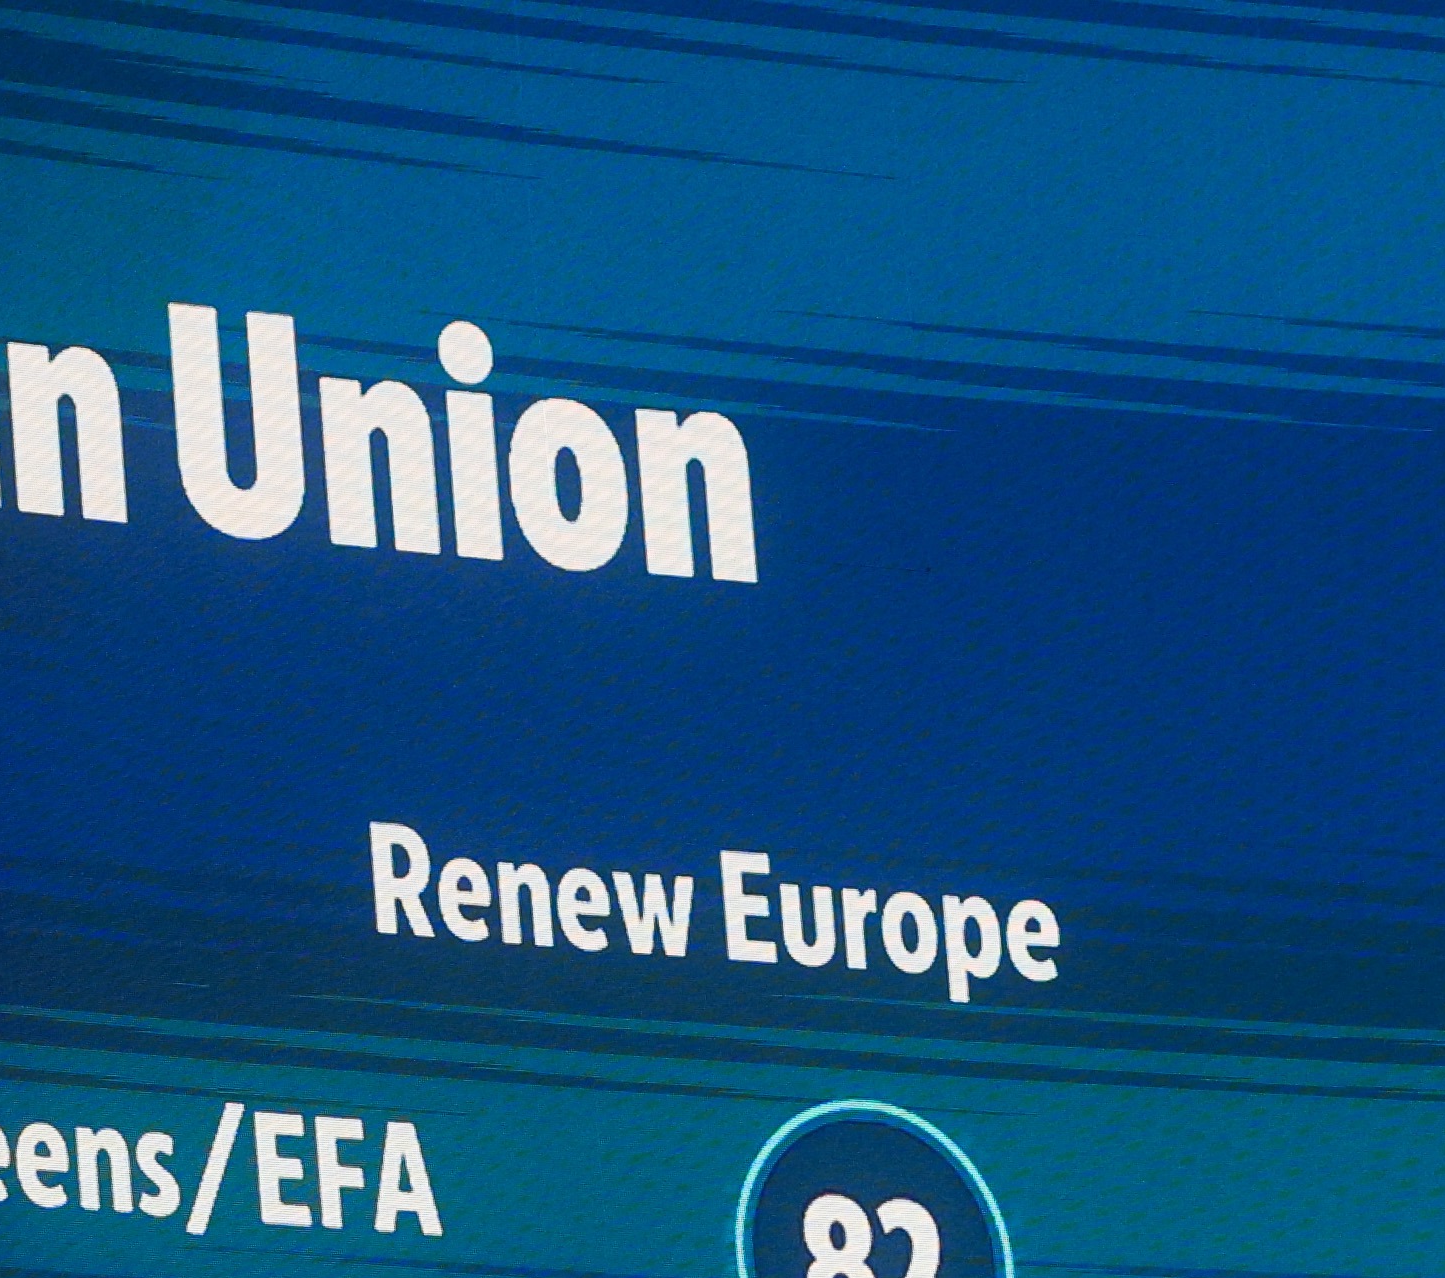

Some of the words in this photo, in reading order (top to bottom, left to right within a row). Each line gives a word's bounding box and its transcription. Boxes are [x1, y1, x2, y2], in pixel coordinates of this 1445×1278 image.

[169, 304, 756, 582] Union
[371, 823, 693, 956] Renew
[721, 851, 1059, 1002] Europe
